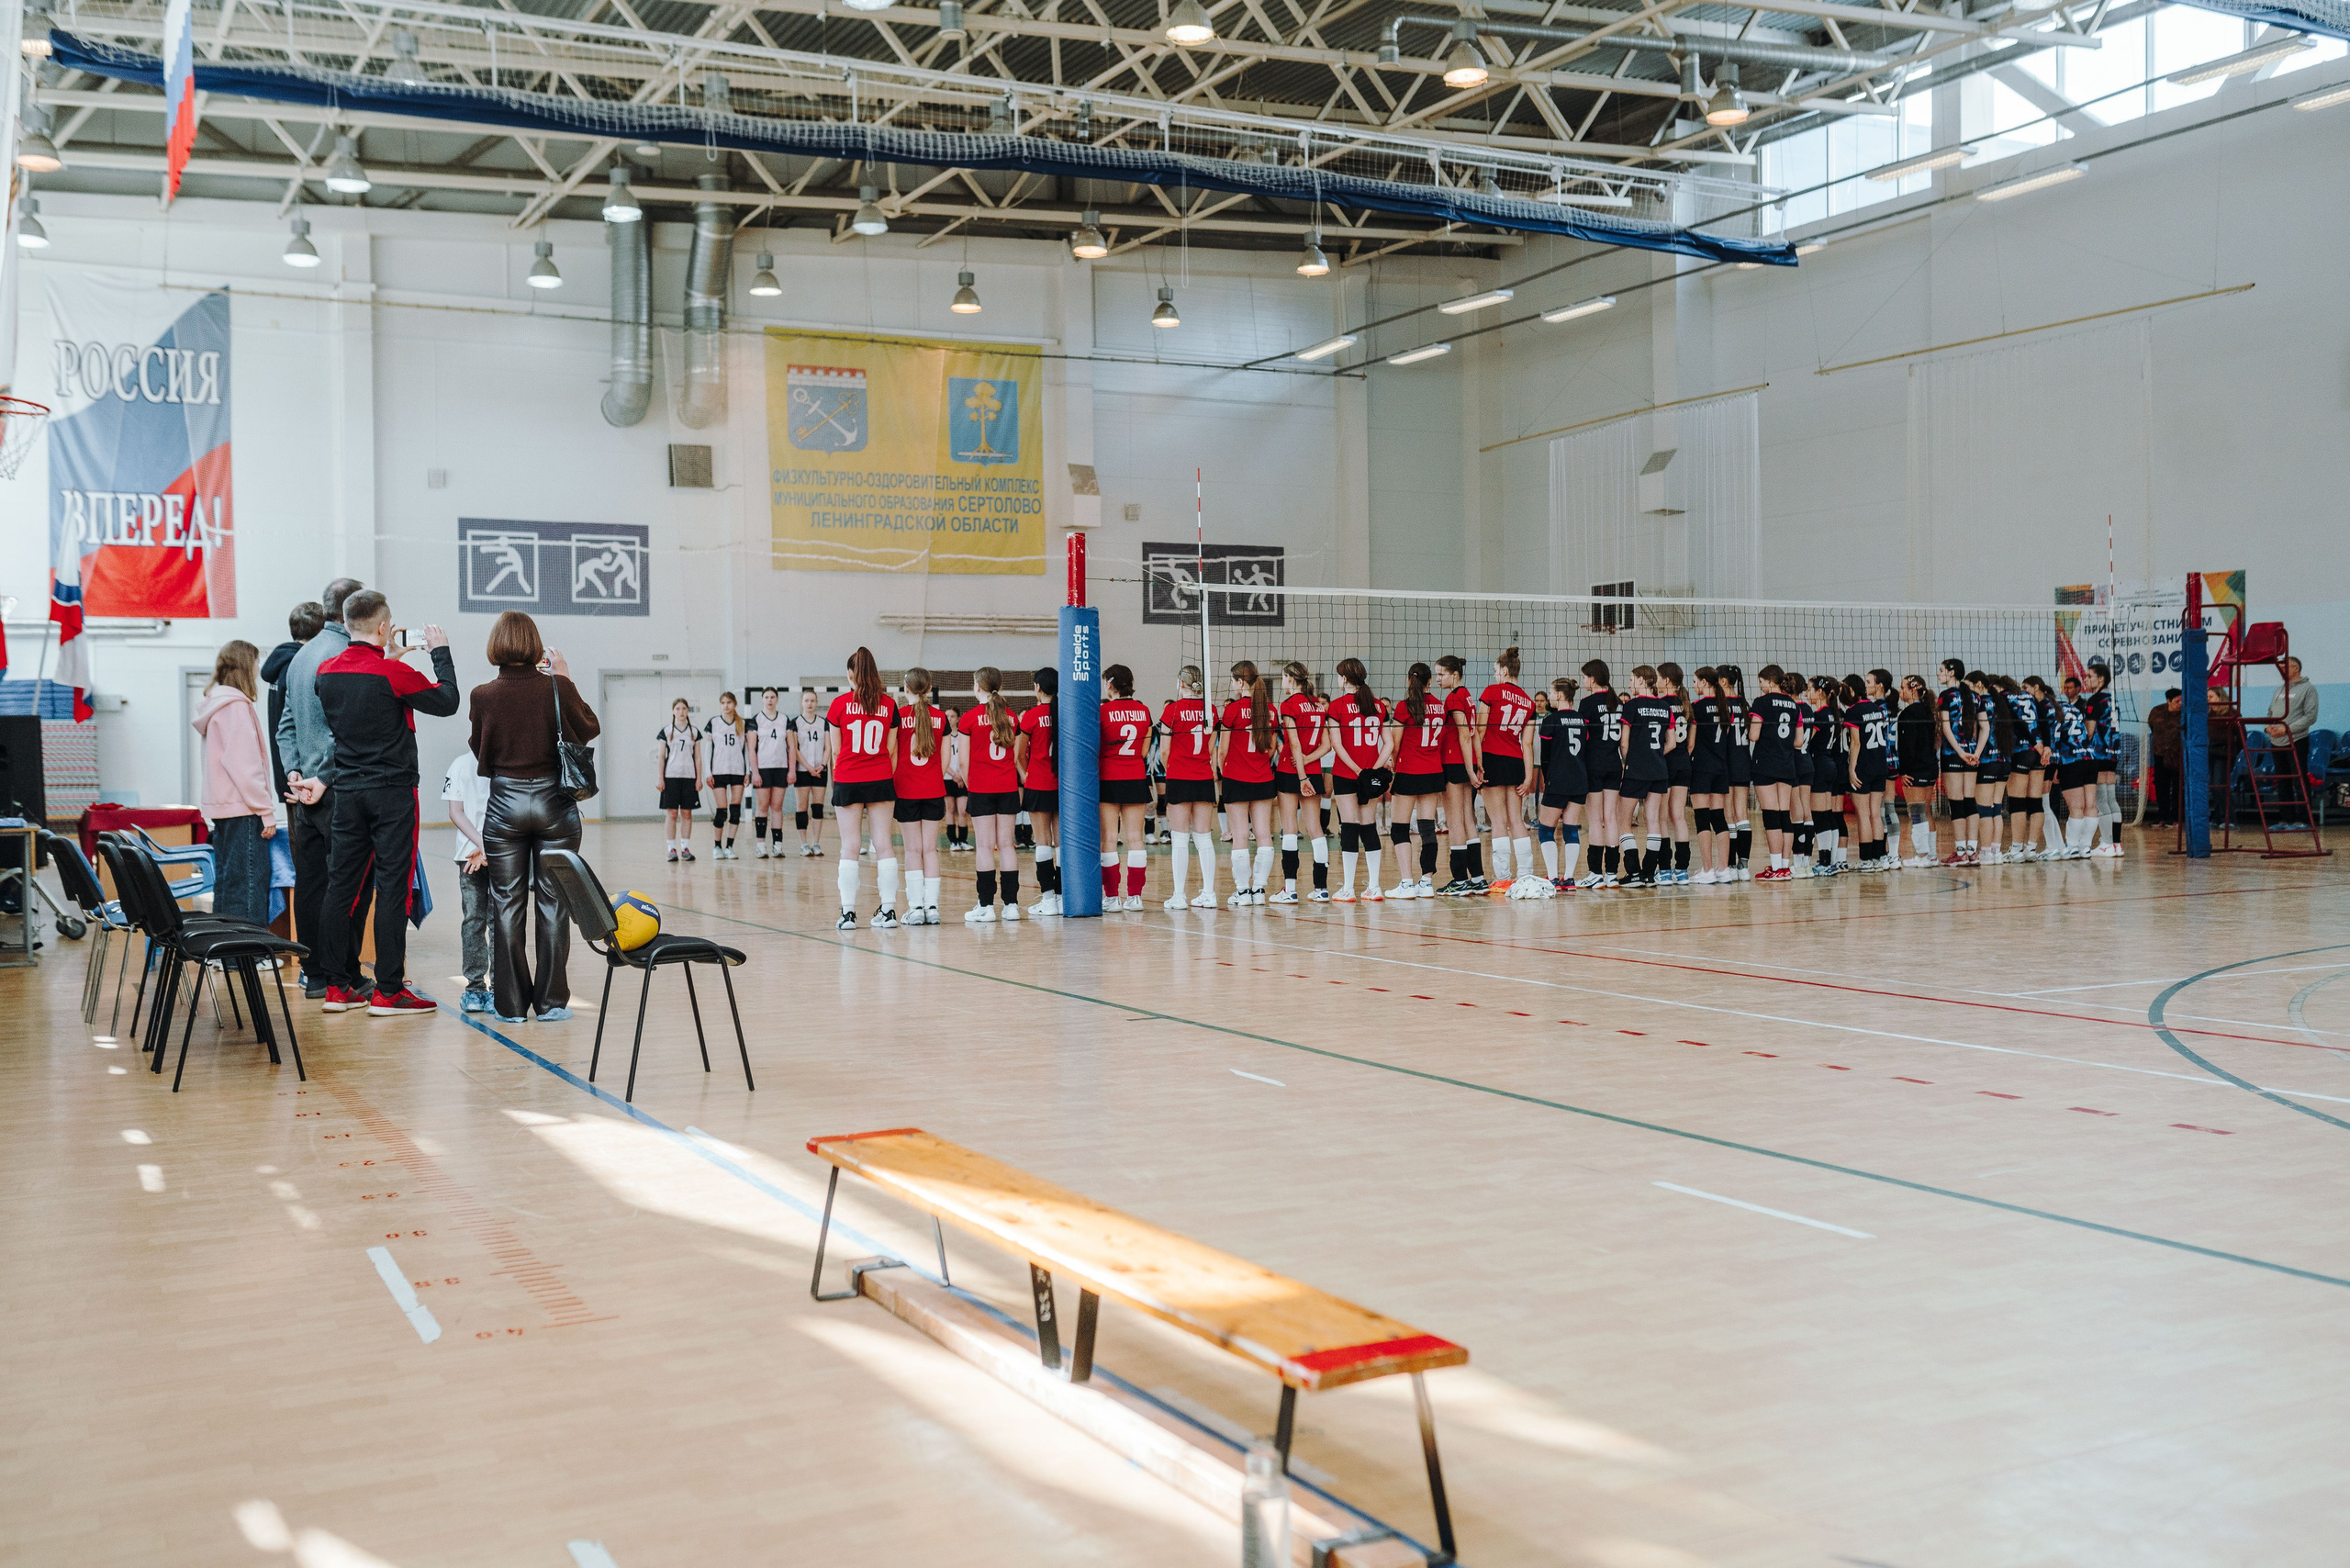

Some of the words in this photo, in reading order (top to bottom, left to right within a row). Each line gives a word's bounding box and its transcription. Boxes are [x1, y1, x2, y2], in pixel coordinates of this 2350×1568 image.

[54, 340, 221, 405] РОССИЯ
[773, 469, 981, 492] ФИЗКУЛЬТУРНО-ОЗДОРОВИТЕЛЬНЫЙ
[985, 476, 1039, 494] КОМПЛЕКС
[774, 491, 876, 509] МУНИЦИПАЛЬНОГО
[878, 494, 955, 512] ОБРАЗОВАНИЯ
[957, 496, 1042, 514] СЕРТОЛОВО
[61, 489, 223, 561] ВПЕРЕД!
[811, 511, 946, 532] ЛЕНИНГРАДСКОЙ
[951, 516, 1019, 532] ОБЛАСТИ
[1072, 624, 1082, 681] Schelde
[1081, 625, 1091, 681] Sports
[1503, 689, 1532, 710] КОЛТУШИ
[2017, 700, 2036, 723] 3
[1108, 711, 1147, 722] КОЛТУШИ
[1308, 715, 1322, 745] 7
[1348, 715, 1381, 746] 13
[1499, 703, 1528, 736] 14
[1599, 712, 1622, 742] 15
[1674, 715, 1687, 744] 8
[1777, 711, 1791, 739] 8
[679, 739, 686, 752] 7
[724, 734, 735, 746] 15
[771, 728, 778, 740] 4
[807, 730, 819, 742] 14
[846, 719, 884, 756] 10
[1117, 723, 1138, 756] 2
[1420, 716, 1444, 747] 12
[1568, 727, 1582, 756] 5
[1648, 721, 1662, 750] 3
